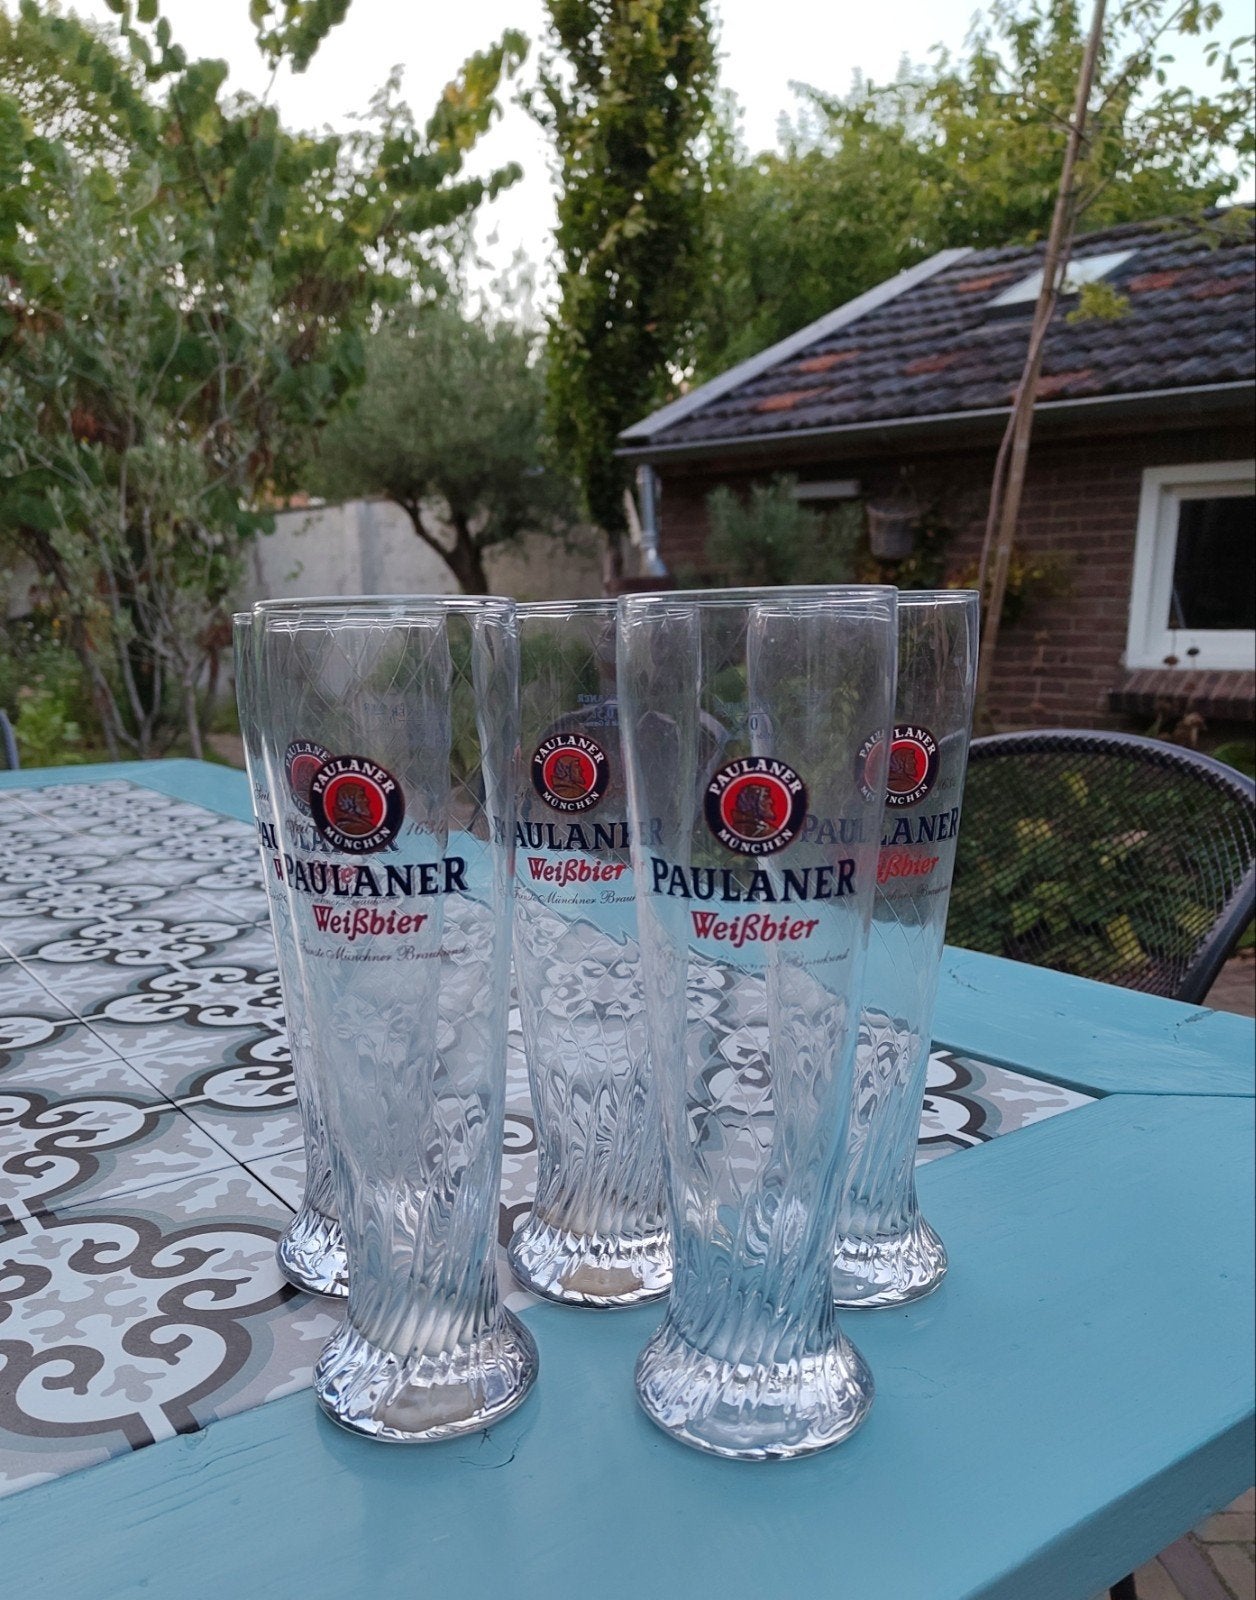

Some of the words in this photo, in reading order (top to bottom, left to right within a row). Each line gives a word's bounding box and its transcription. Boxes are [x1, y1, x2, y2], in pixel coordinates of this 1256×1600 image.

[285, 743, 331, 769] PAULANE
[534, 736, 605, 765] PAULANER
[312, 759, 395, 795] PAULANER
[709, 758, 803, 795] PAULANER
[284, 854, 468, 897] PAULANER
[527, 856, 627, 887] Weißbier
[651, 856, 856, 902] PAULANER
[312, 904, 428, 941] Weißbier
[691, 911, 819, 948] Weißbier
